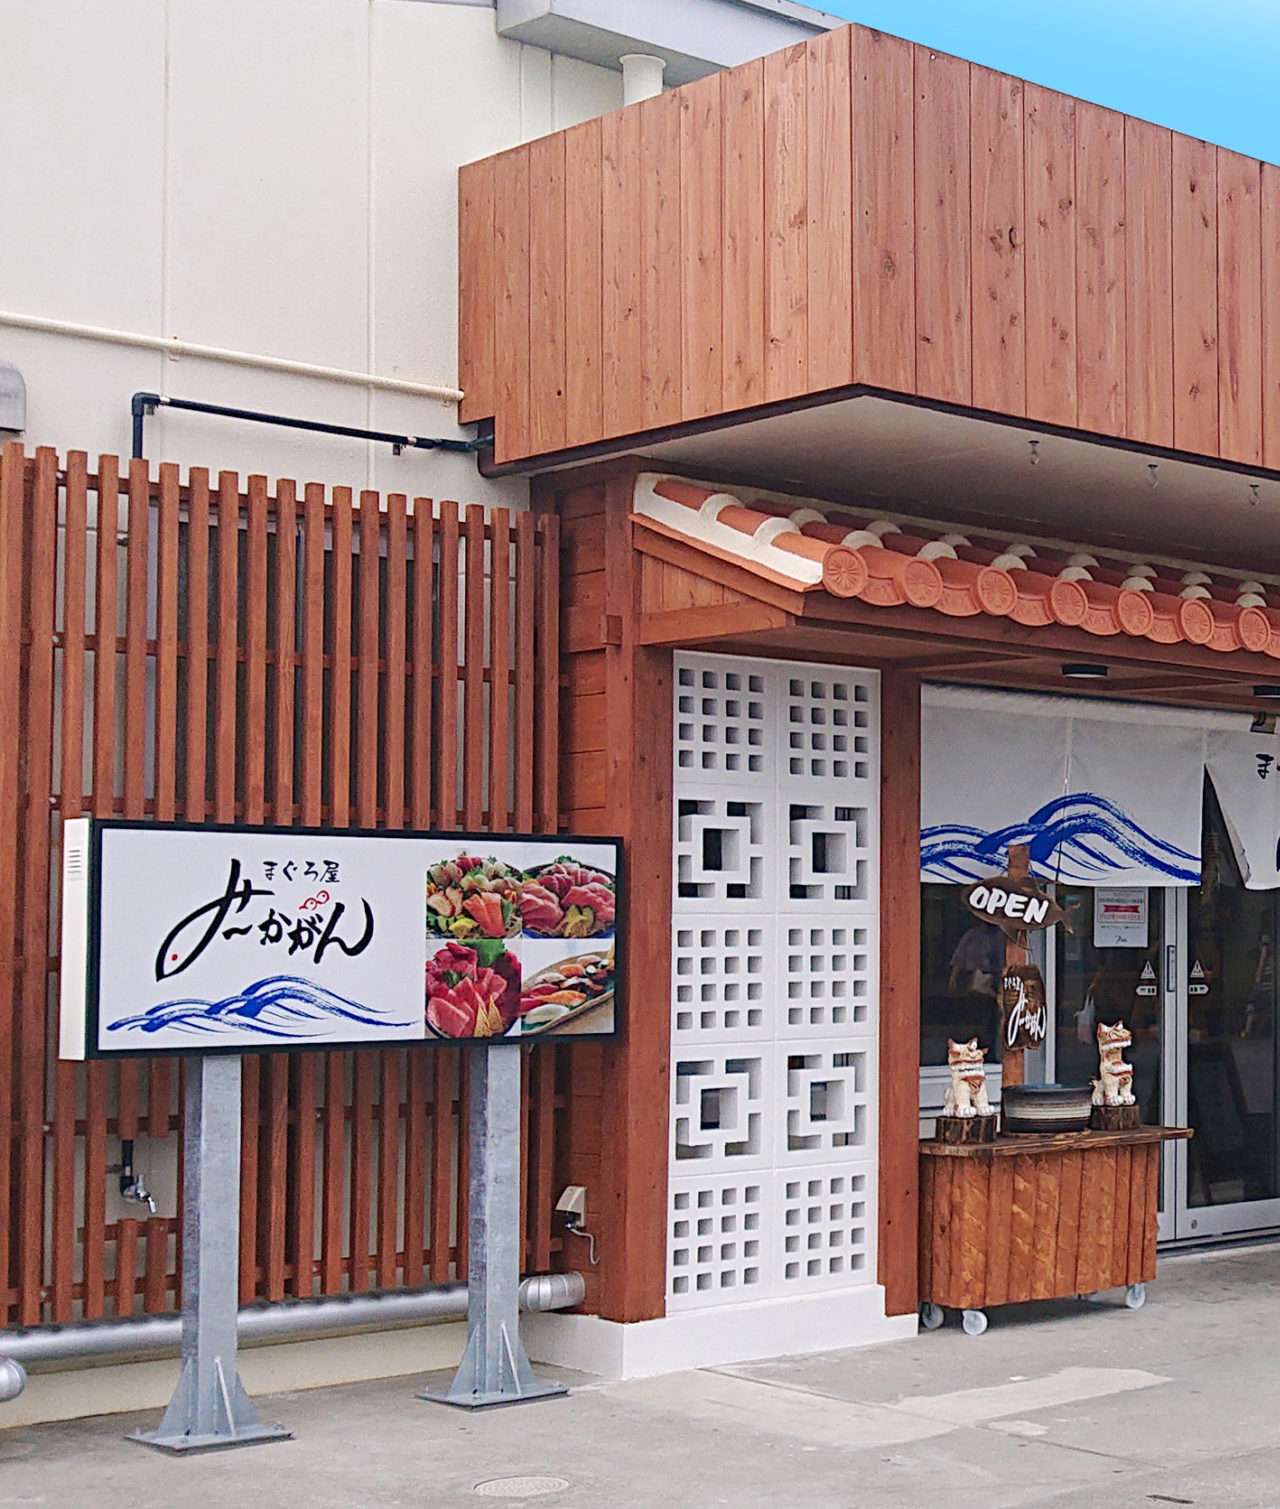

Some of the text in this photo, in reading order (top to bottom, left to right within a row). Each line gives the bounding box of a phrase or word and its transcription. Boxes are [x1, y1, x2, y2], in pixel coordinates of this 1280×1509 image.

[263, 860, 341, 882] まぐろ屋
[969, 885, 1049, 923] OPEN
